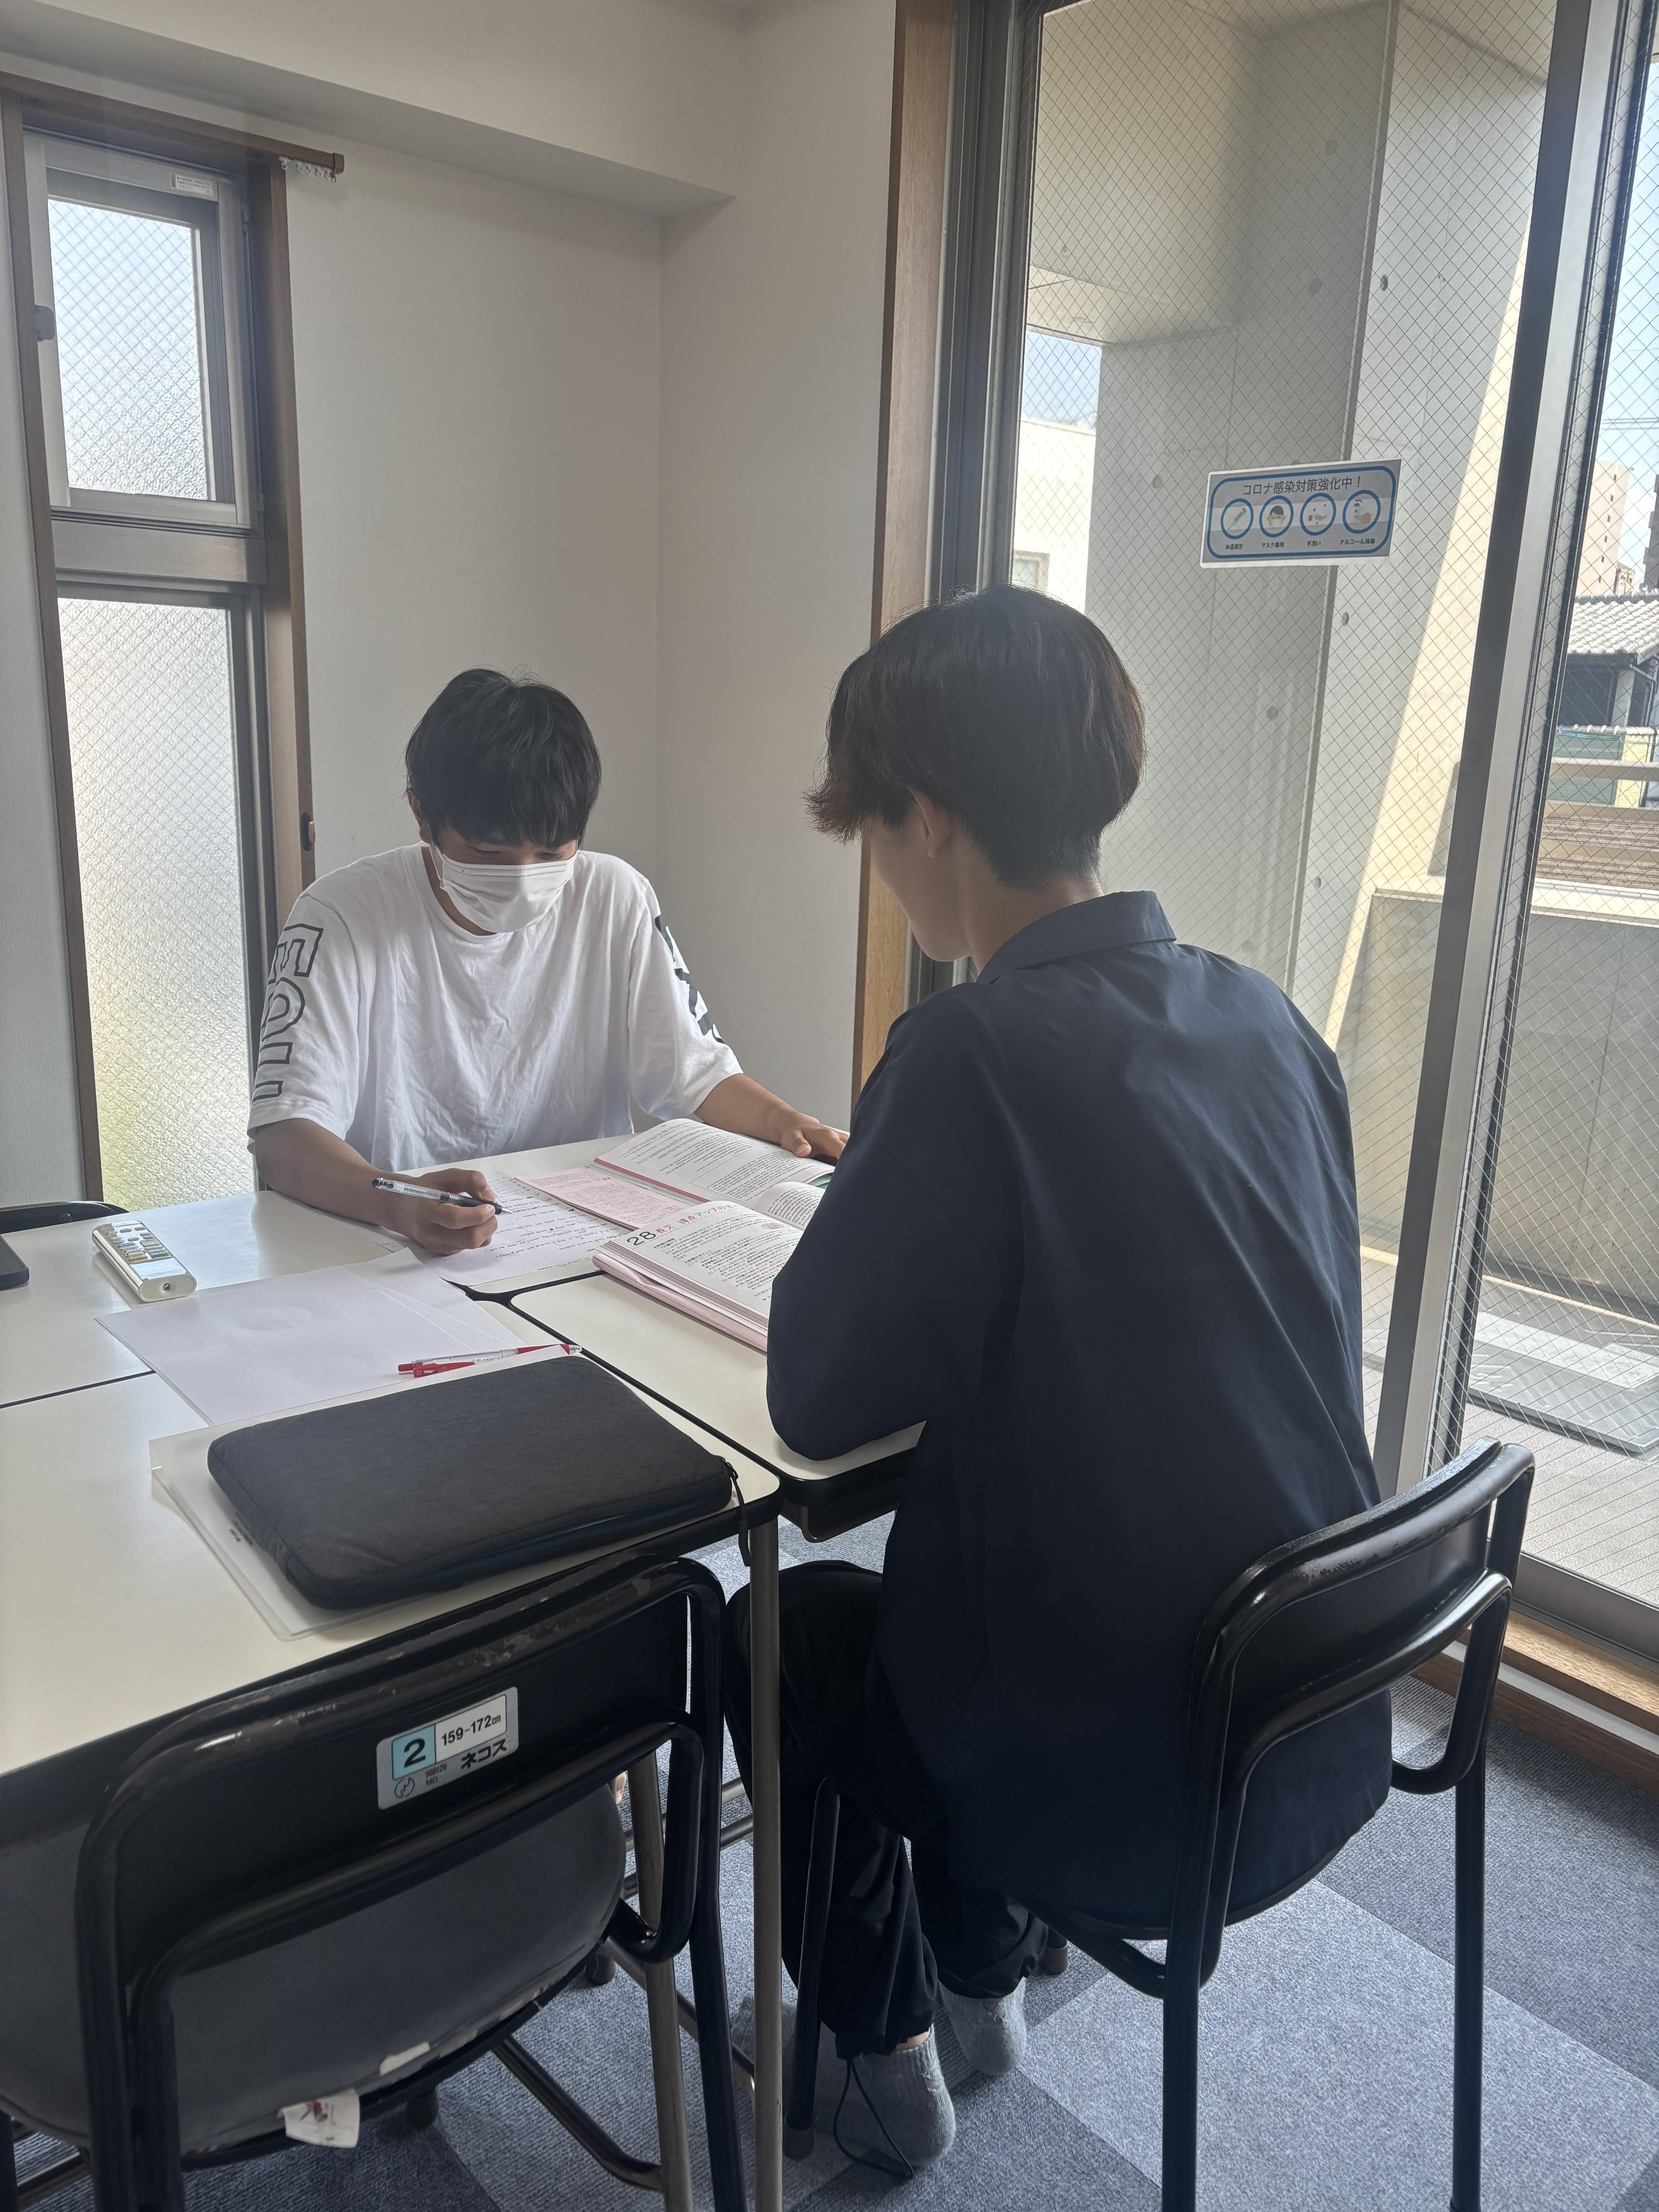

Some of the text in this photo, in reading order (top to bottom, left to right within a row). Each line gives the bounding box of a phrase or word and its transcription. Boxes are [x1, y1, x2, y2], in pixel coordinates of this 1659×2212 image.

[1243, 476, 1360, 495] コロナ感染対策強化中！
[627, 1231, 656, 1245] 28
[404, 1738, 425, 1768] 2
[461, 1739, 507, 1769] ネコス
